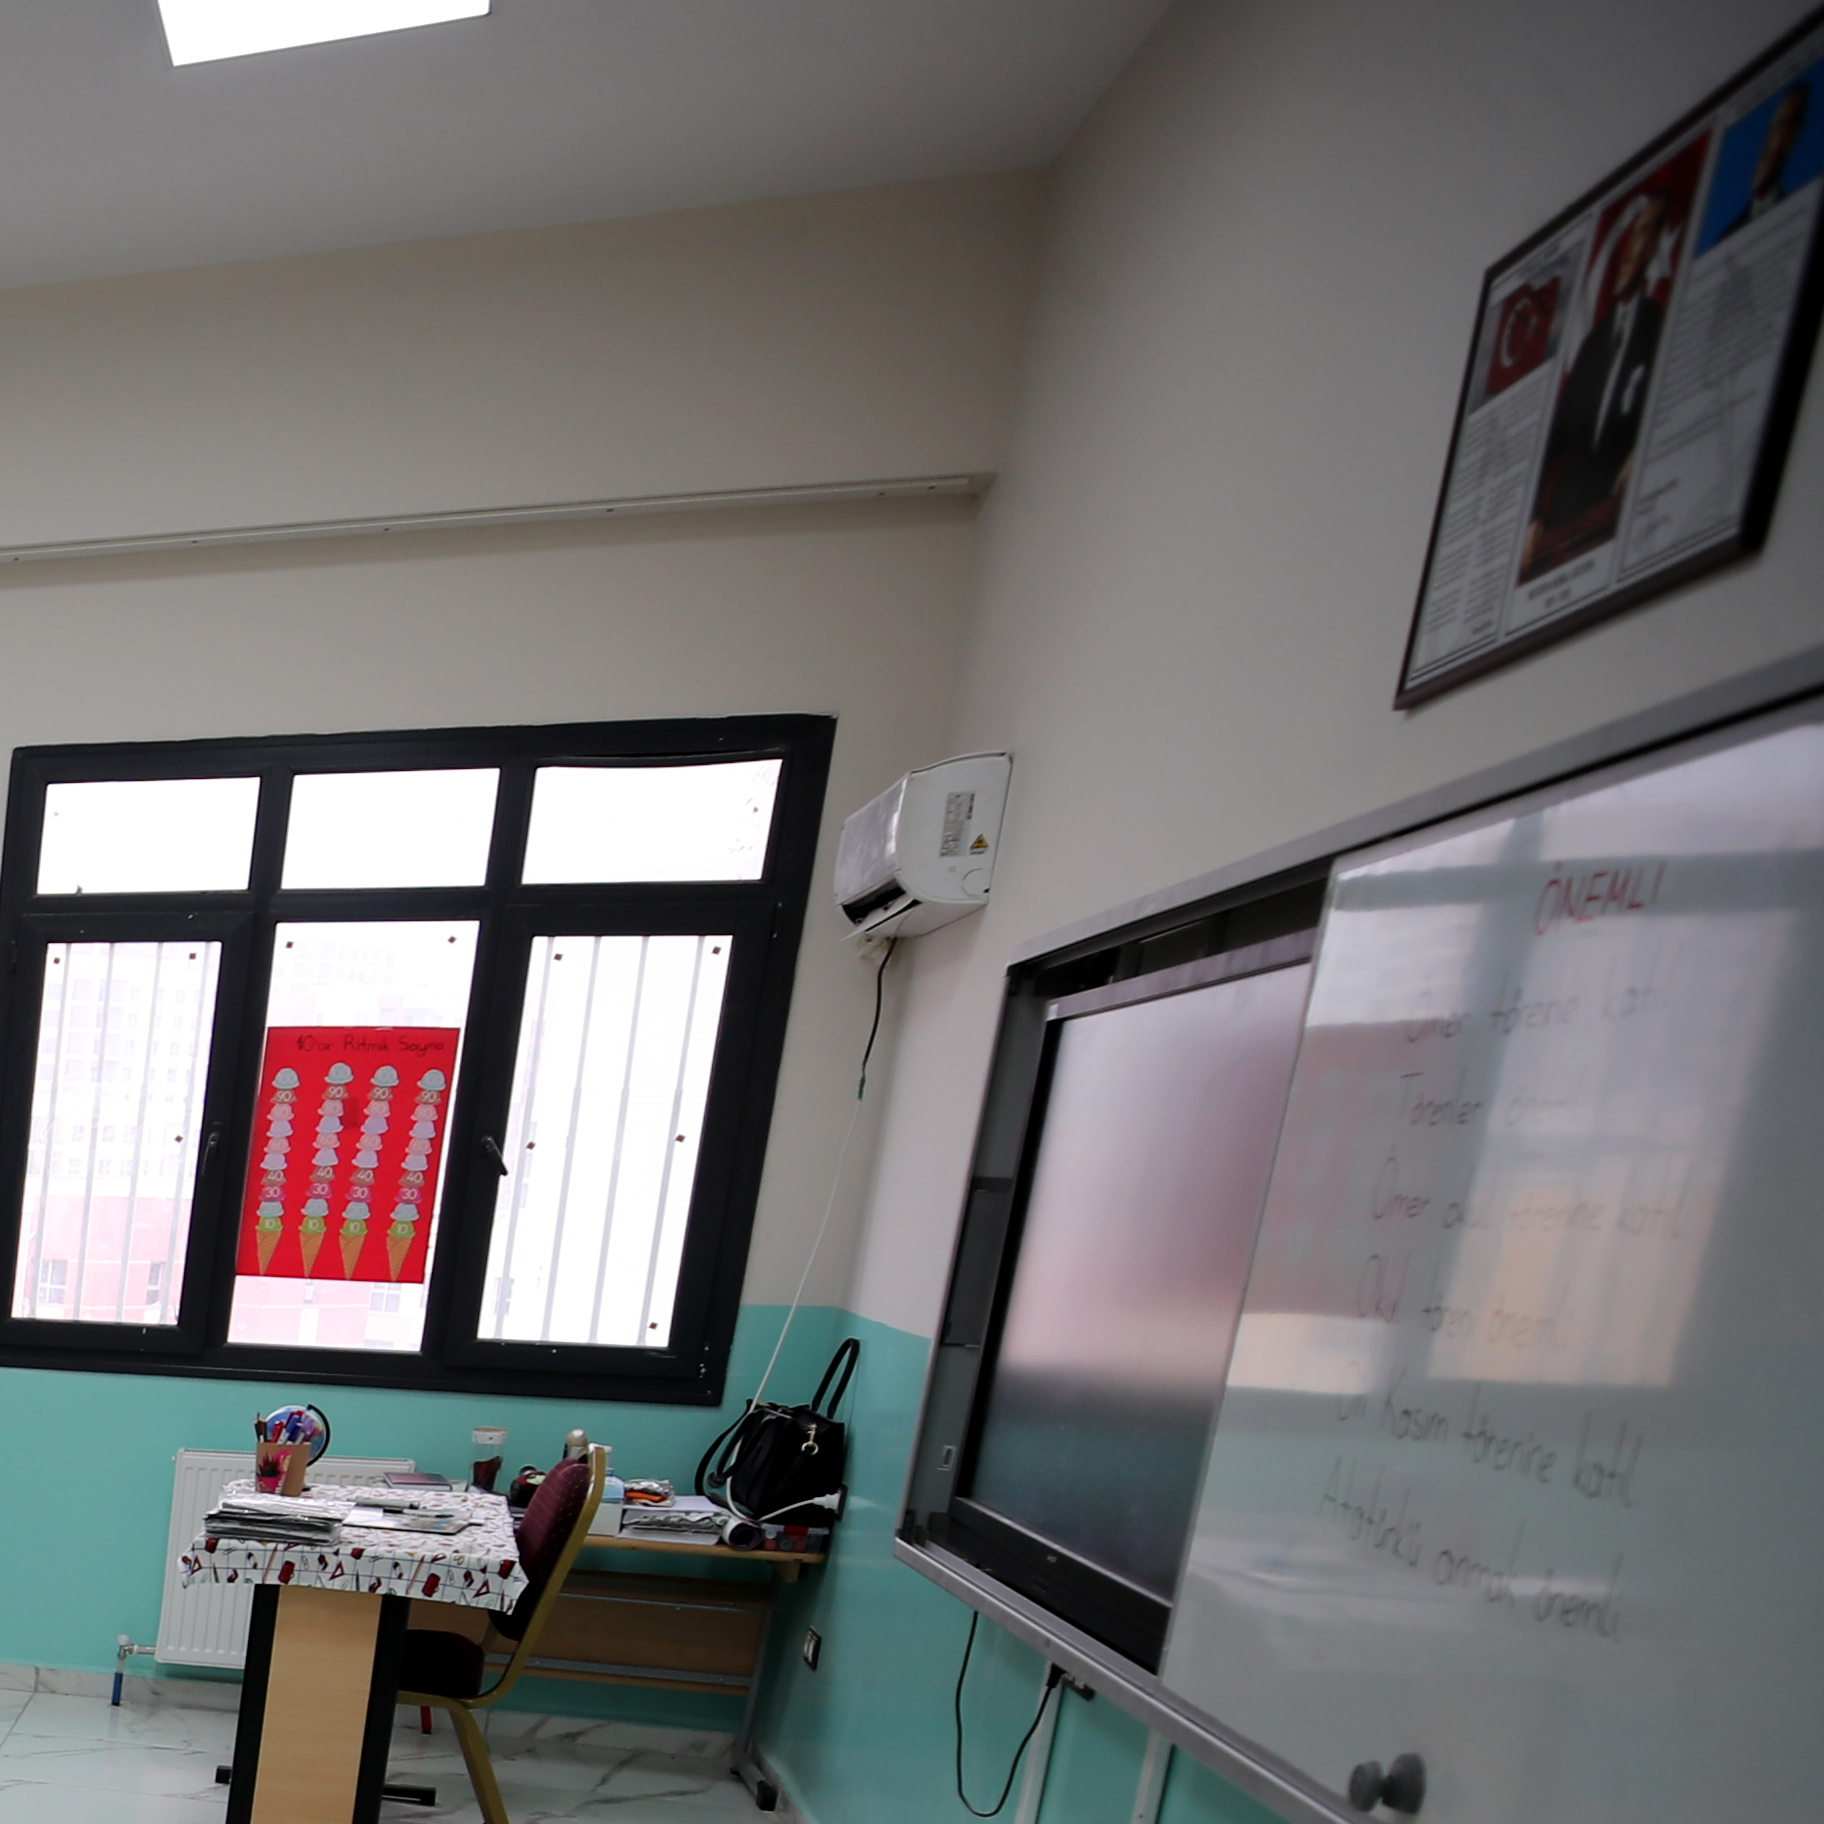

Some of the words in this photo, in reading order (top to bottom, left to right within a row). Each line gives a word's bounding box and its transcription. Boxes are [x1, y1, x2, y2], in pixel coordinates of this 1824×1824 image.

[277, 1092, 292, 1102] 90
[329, 1087, 344, 1098] 90
[374, 1088, 389, 1099] 90
[422, 1091, 437, 1102] 90
[268, 1171, 284, 1182] 40
[317, 1167, 333, 1179] 40
[357, 1170, 374, 1181] 40
[406, 1172, 423, 1183] 40
[266, 1187, 280, 1198] 30
[313, 1184, 328, 1195] 30
[353, 1188, 368, 1199] 30
[403, 1189, 417, 1200] 30
[265, 1219, 275, 1229] 10
[308, 1219, 319, 1230] 10
[350, 1222, 360, 1233] 10
[397, 1224, 408, 1234] 10
